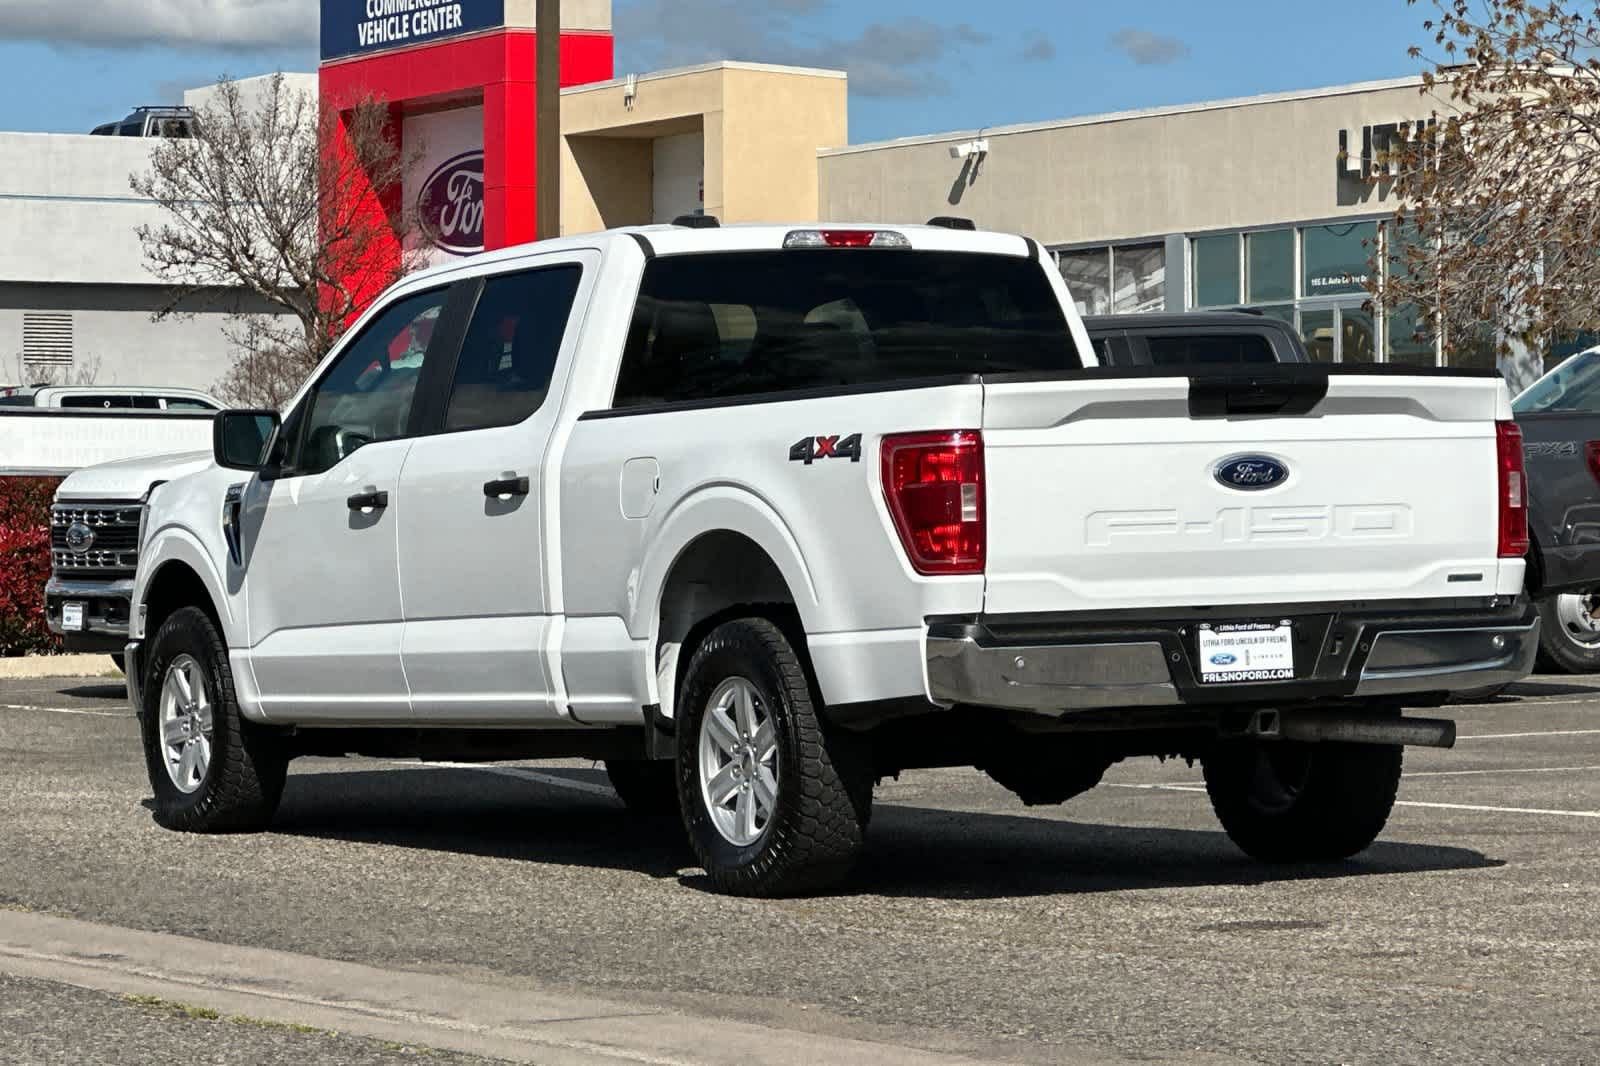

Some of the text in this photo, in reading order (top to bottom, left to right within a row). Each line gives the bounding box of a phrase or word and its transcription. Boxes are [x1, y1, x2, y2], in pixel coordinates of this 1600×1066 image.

[358, 4, 463, 46] VEHICLE CENTER
[440, 169, 484, 237] For
[1233, 462, 1274, 482] Ford
[1083, 502, 1415, 547] F-150
[1235, 623, 1247, 631] Ford
[1203, 635, 1287, 648] LITHIA FORD LINCOLN OF FRESNO
[1202, 669, 1294, 683] FRESNOFORD.COM
